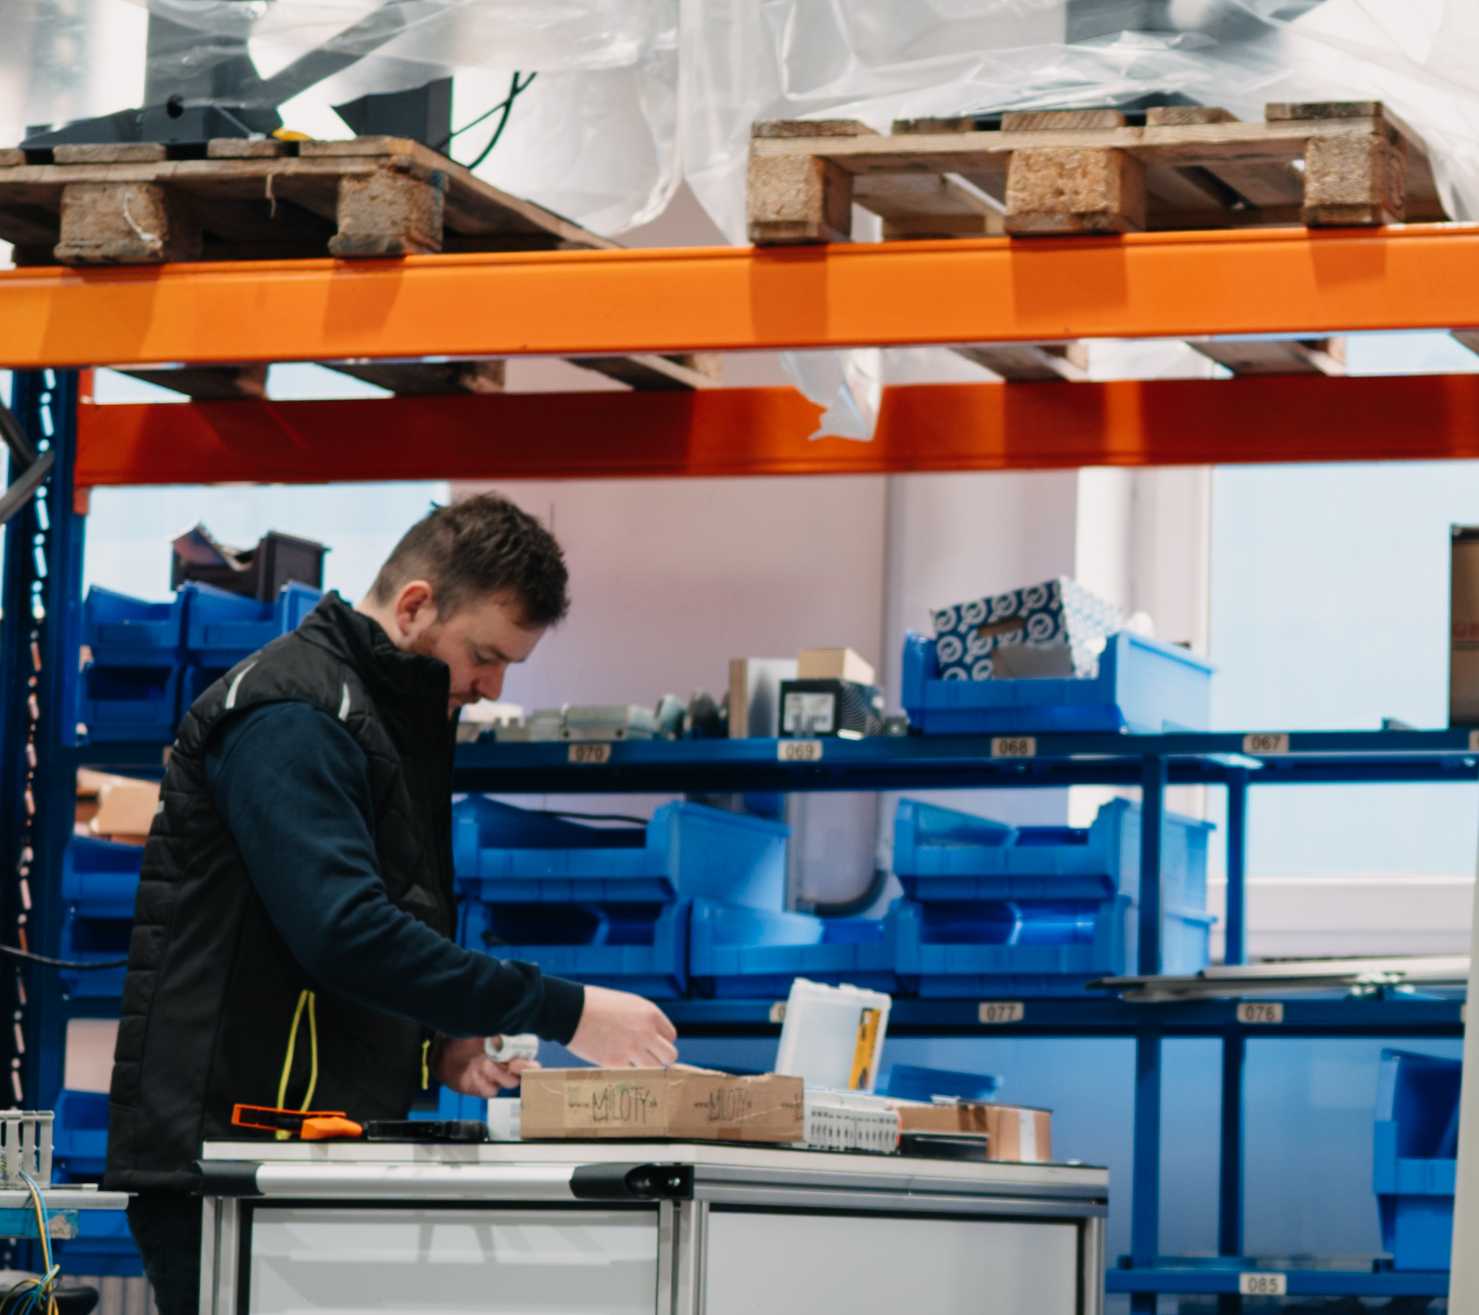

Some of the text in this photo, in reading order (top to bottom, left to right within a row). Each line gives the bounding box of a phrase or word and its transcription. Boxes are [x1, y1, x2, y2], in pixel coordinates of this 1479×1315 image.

[1252, 735, 1281, 750] 067
[786, 744, 815, 758] 069
[987, 1006, 1016, 1020] 077
[1245, 1006, 1276, 1021] 076
[1248, 1277, 1279, 1293] 085
